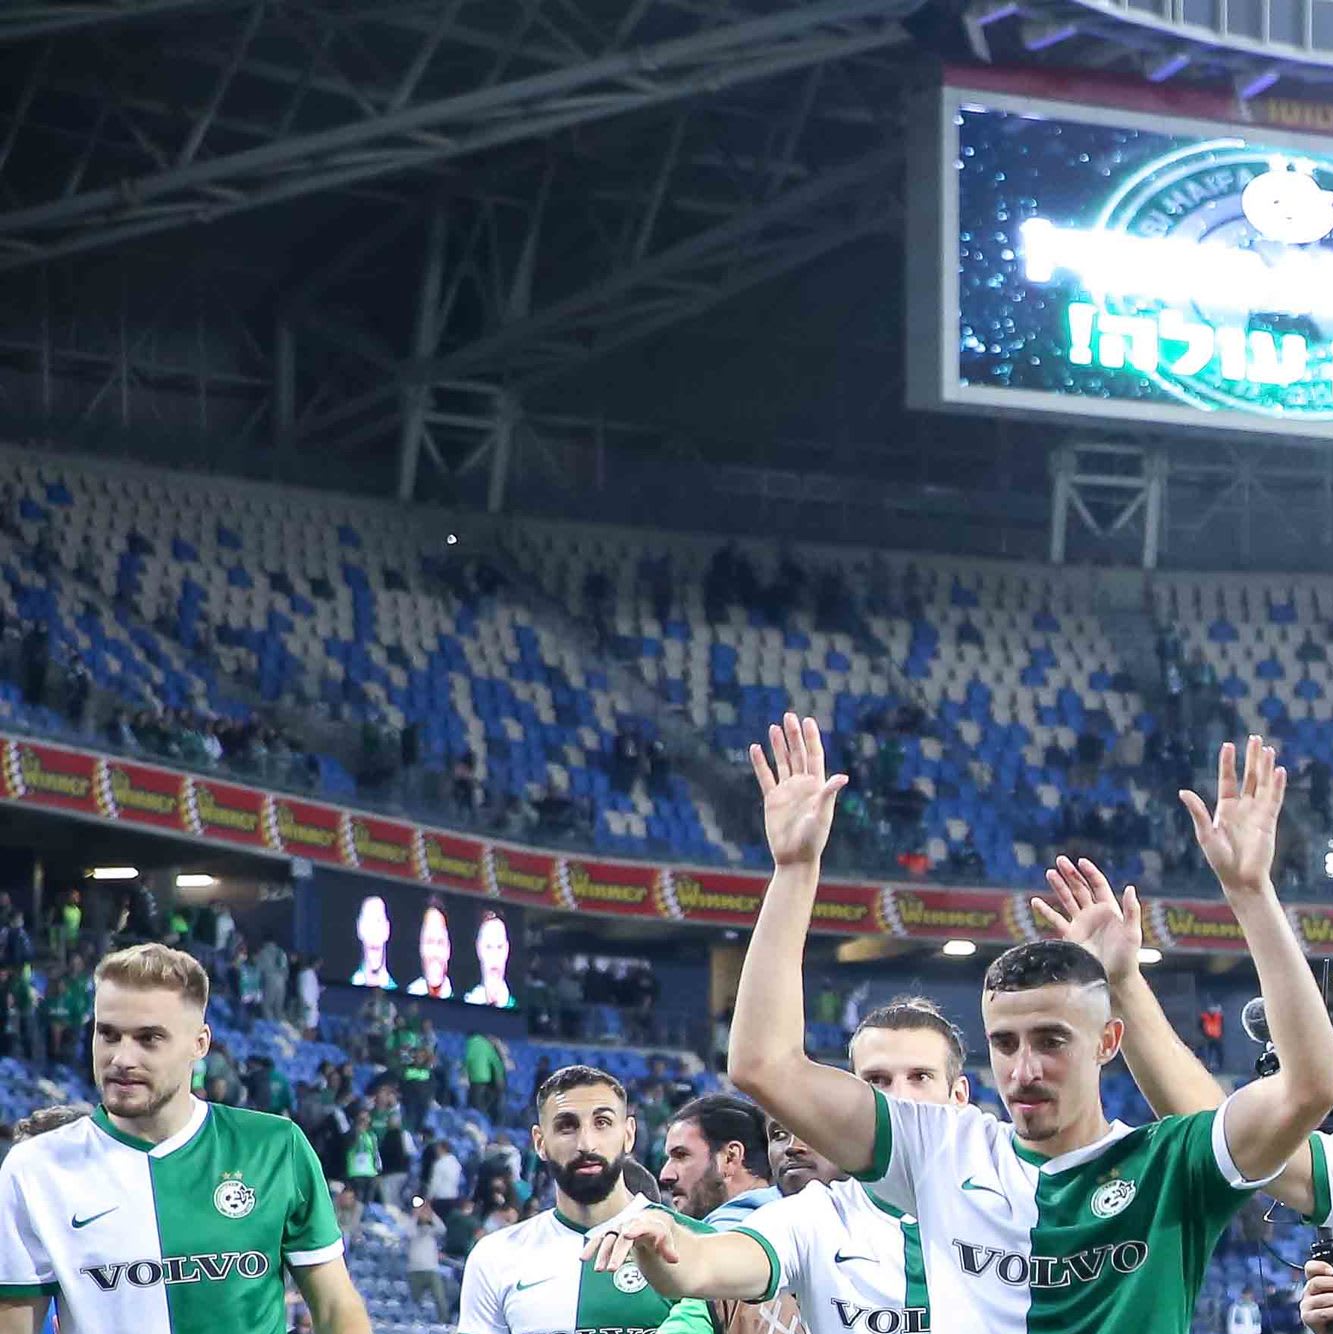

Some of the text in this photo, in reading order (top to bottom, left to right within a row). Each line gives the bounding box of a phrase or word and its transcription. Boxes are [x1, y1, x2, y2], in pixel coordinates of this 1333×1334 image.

[1066, 302, 1307, 387] עולה!
[80, 1250, 269, 1291] VOLVO
[952, 1239, 1149, 1288] VOLVO
